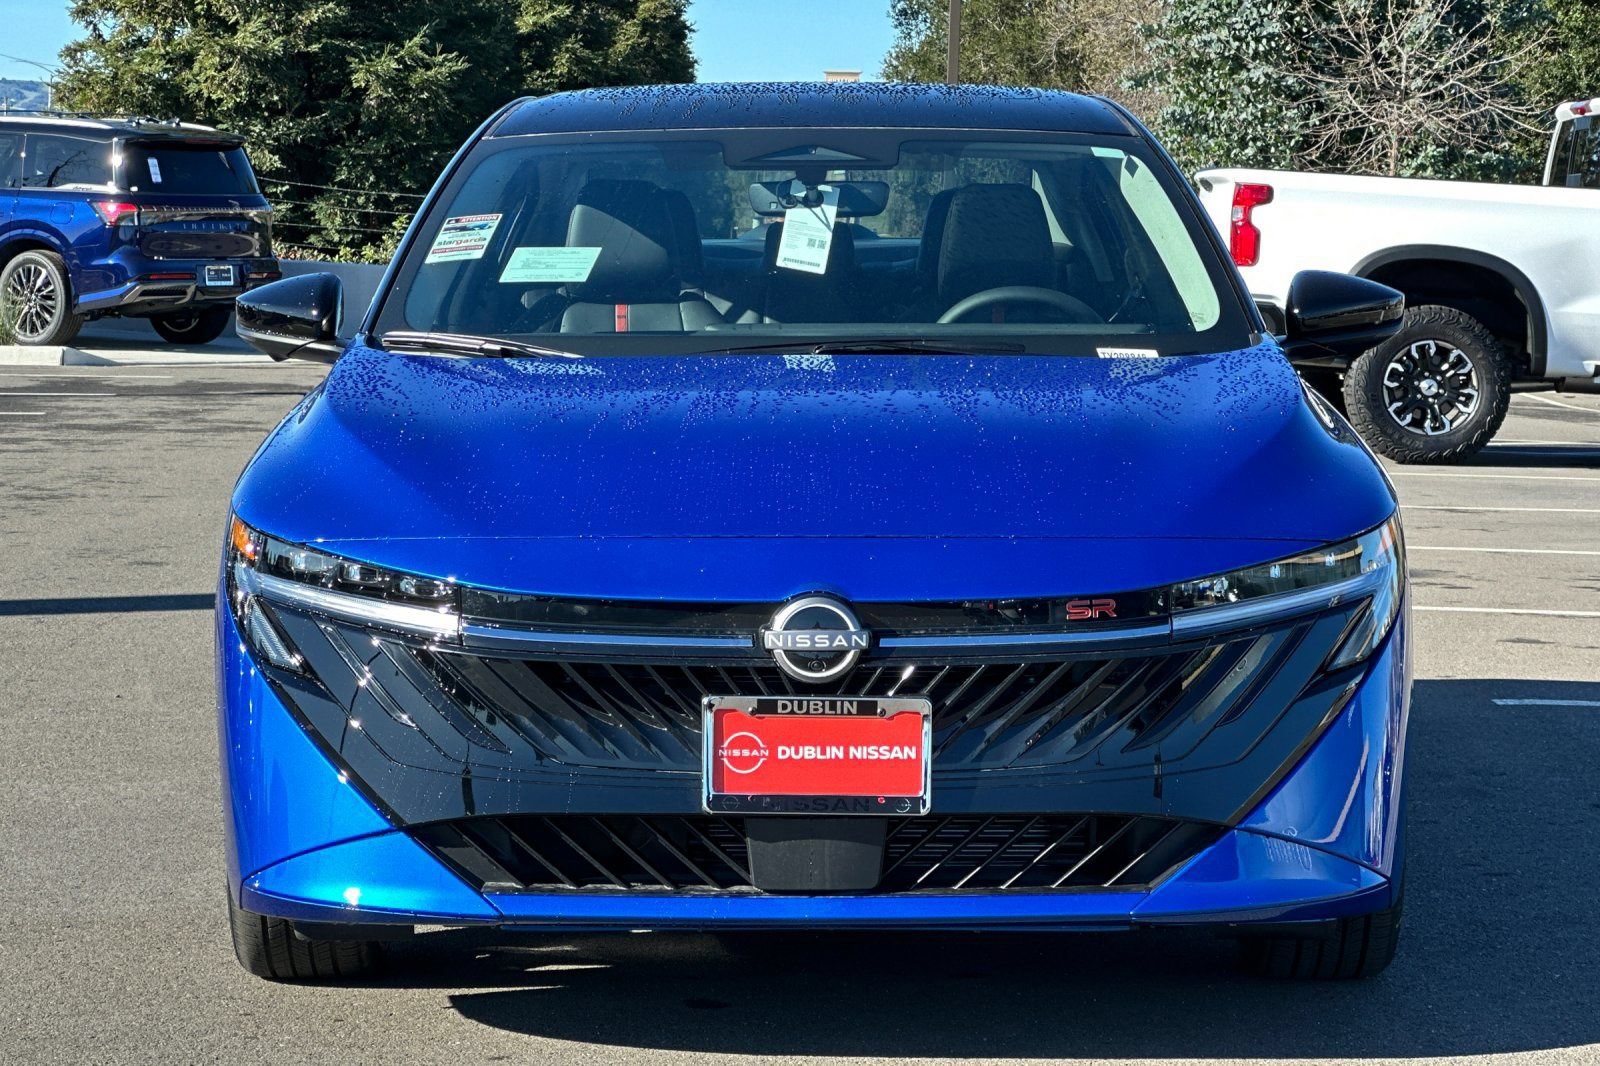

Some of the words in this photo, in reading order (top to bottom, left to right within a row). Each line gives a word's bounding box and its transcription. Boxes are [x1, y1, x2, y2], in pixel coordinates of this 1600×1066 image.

[1066, 599, 1118, 620] SR
[768, 634, 867, 648] NISSAN
[777, 700, 858, 715] DUBLIN
[718, 748, 769, 757] NISSAN
[777, 746, 844, 760] DUBLIN
[849, 746, 916, 760] NISSAN
